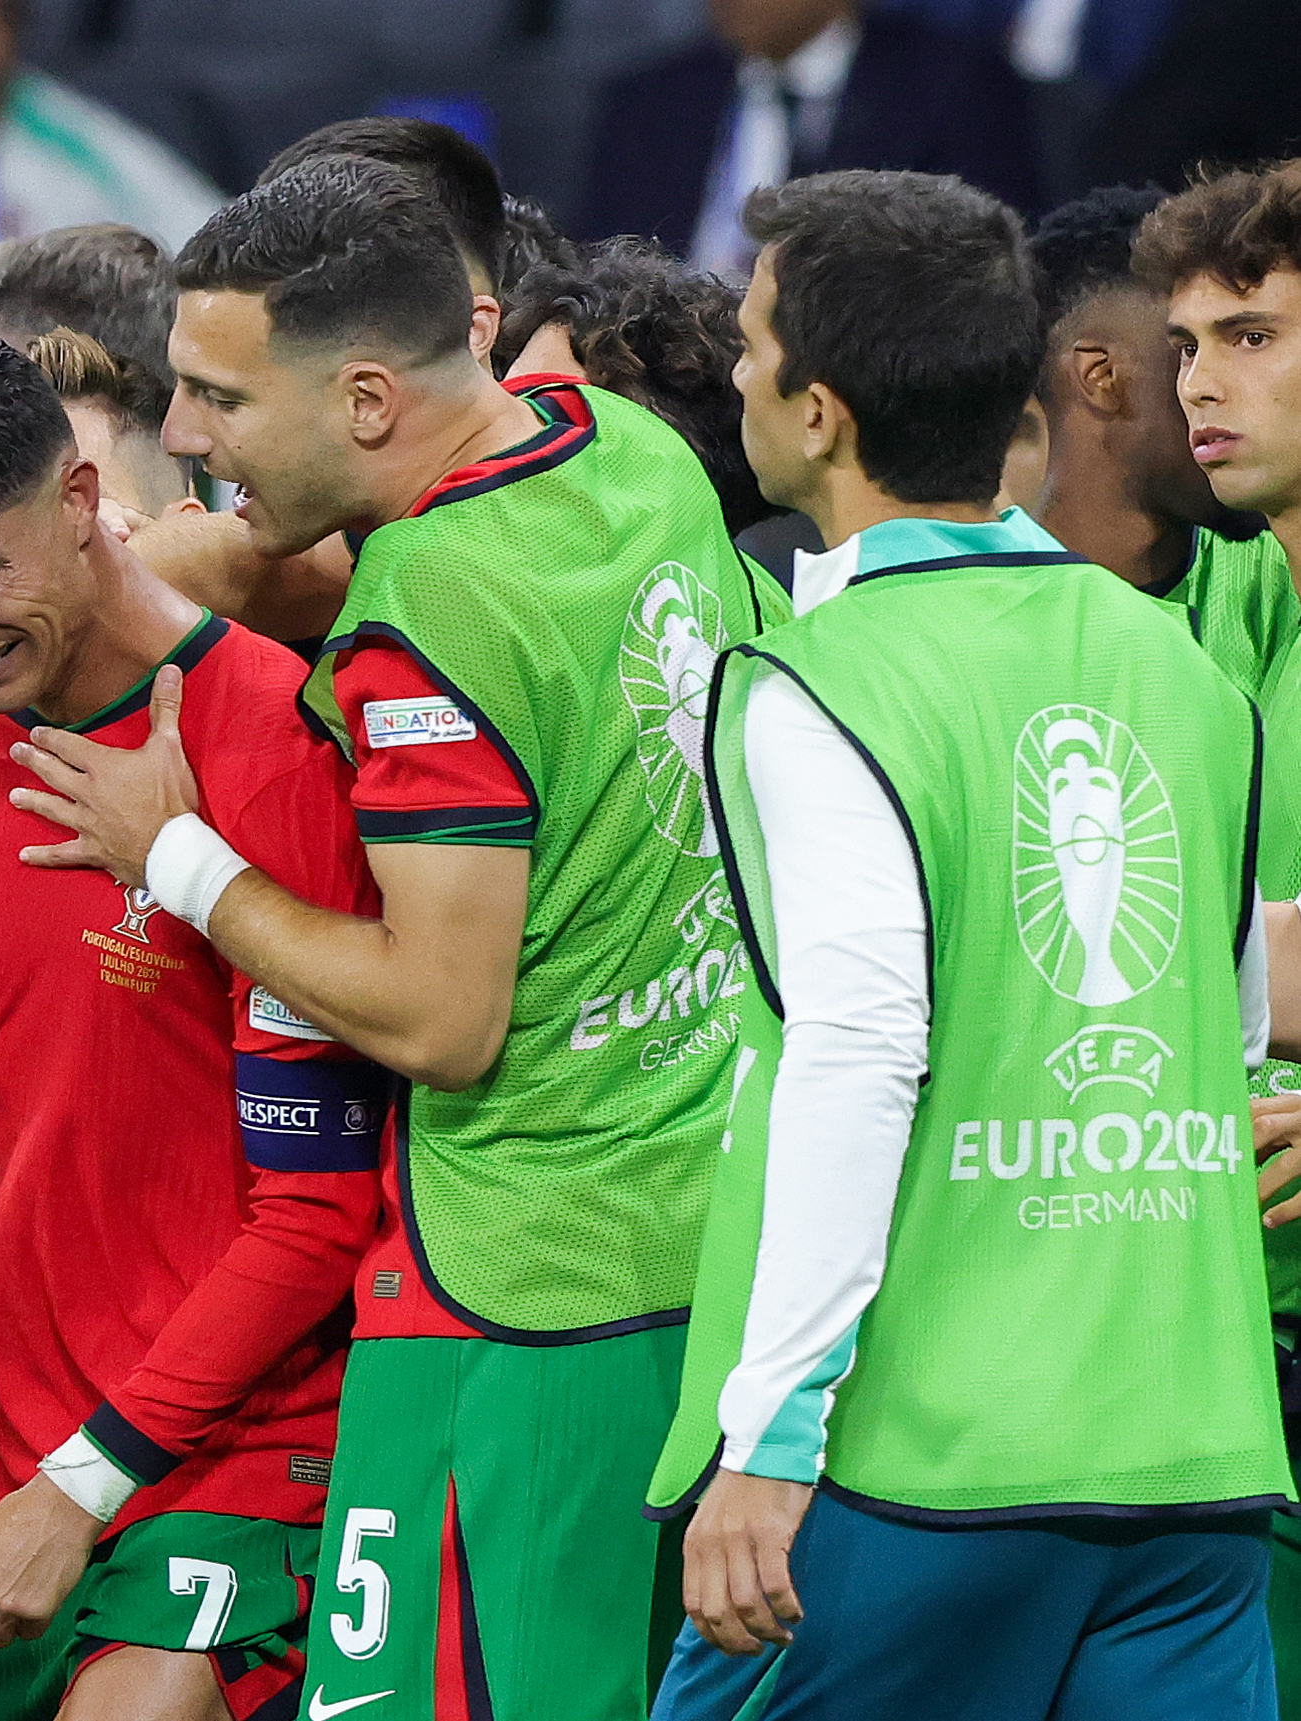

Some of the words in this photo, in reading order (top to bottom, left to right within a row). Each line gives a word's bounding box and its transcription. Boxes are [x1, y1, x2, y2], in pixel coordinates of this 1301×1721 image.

[100, 968, 158, 993] FRANKFURT
[104, 955, 136, 975] JULHO
[136, 965, 162, 980] 2024
[1052, 1038, 1163, 1092] UEFA
[240, 1099, 320, 1128] RESPECT
[949, 1109, 1243, 1181] EURO2024
[168, 1556, 238, 1650] 7
[329, 1507, 396, 1661] 5
